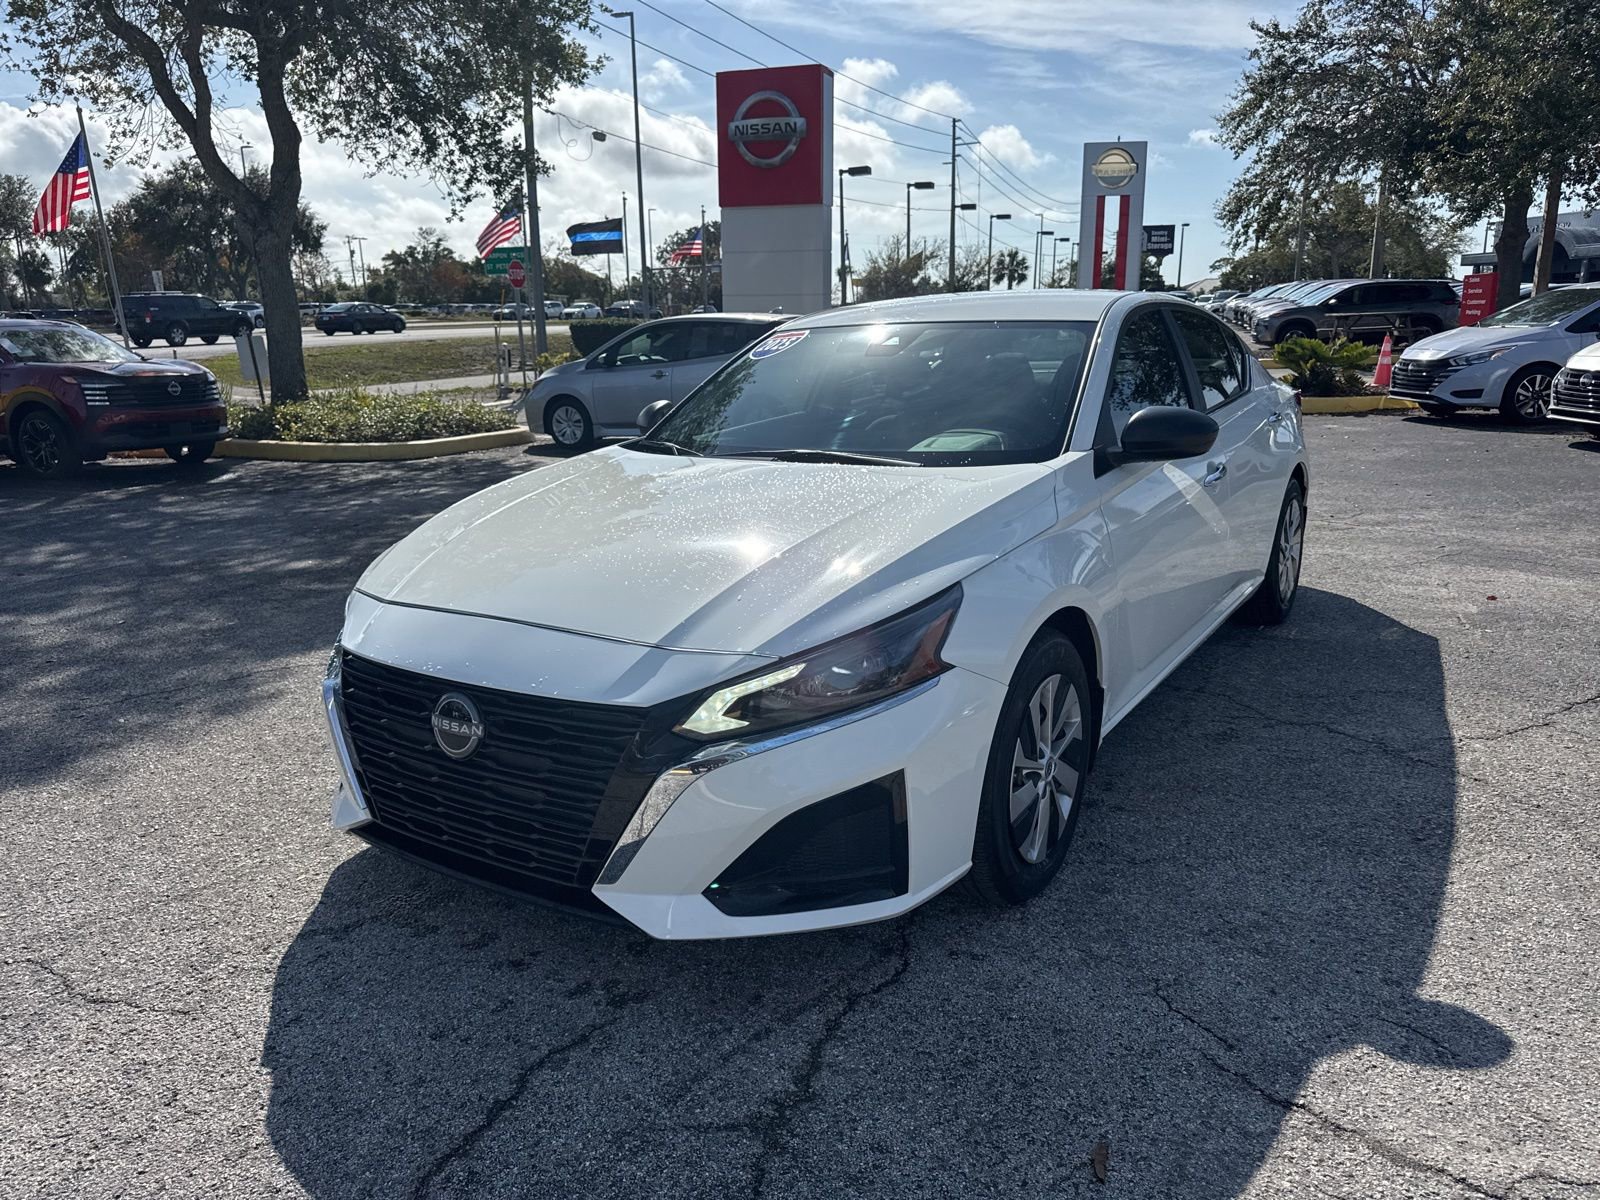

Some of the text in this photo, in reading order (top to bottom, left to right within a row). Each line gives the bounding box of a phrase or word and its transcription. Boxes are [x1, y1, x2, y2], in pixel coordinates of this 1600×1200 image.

[734, 121, 798, 137] NISSAN
[1147, 242, 1173, 250] Storage
[509, 269, 525, 280] STOP
[755, 336, 797, 352] 2025
[431, 714, 483, 736] NISSAN
